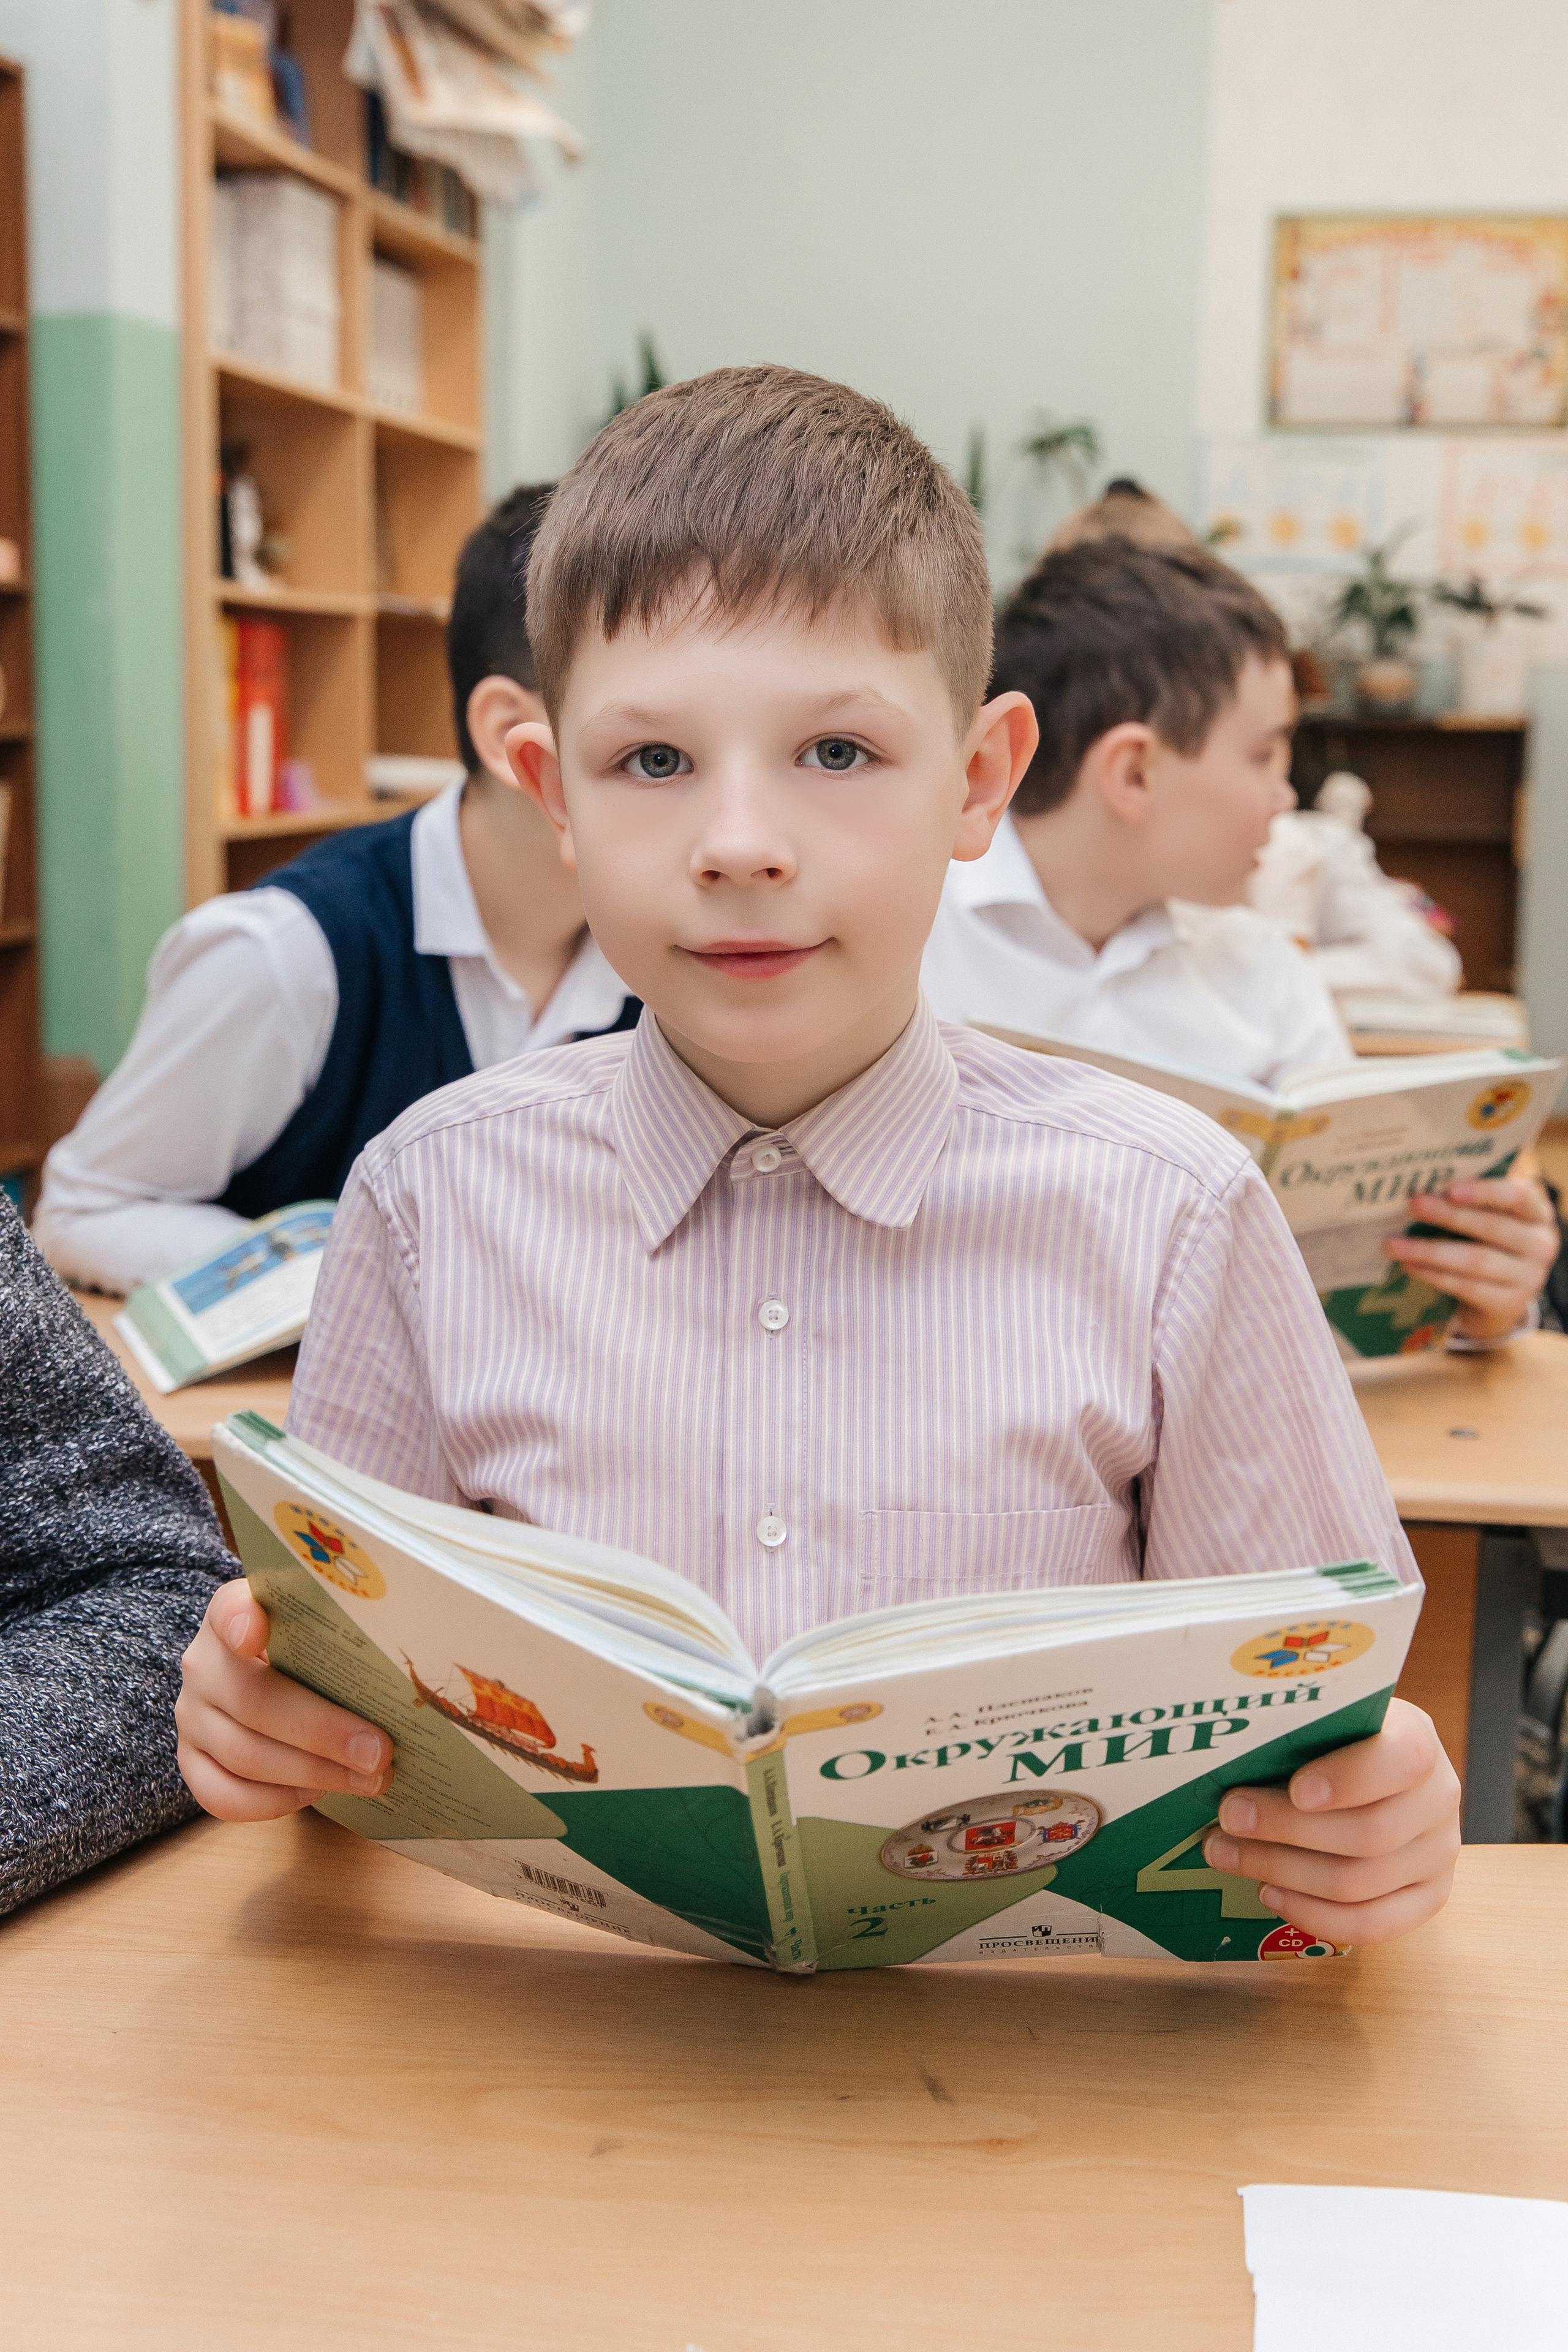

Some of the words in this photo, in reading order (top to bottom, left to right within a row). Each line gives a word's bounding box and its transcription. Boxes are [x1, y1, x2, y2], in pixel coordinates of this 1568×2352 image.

[820, 1681, 1325, 1781] Окружающий
[1001, 1717, 1250, 1784] МИР
[850, 1917, 889, 1940] 2
[1278, 1939, 1303, 1948] CD
